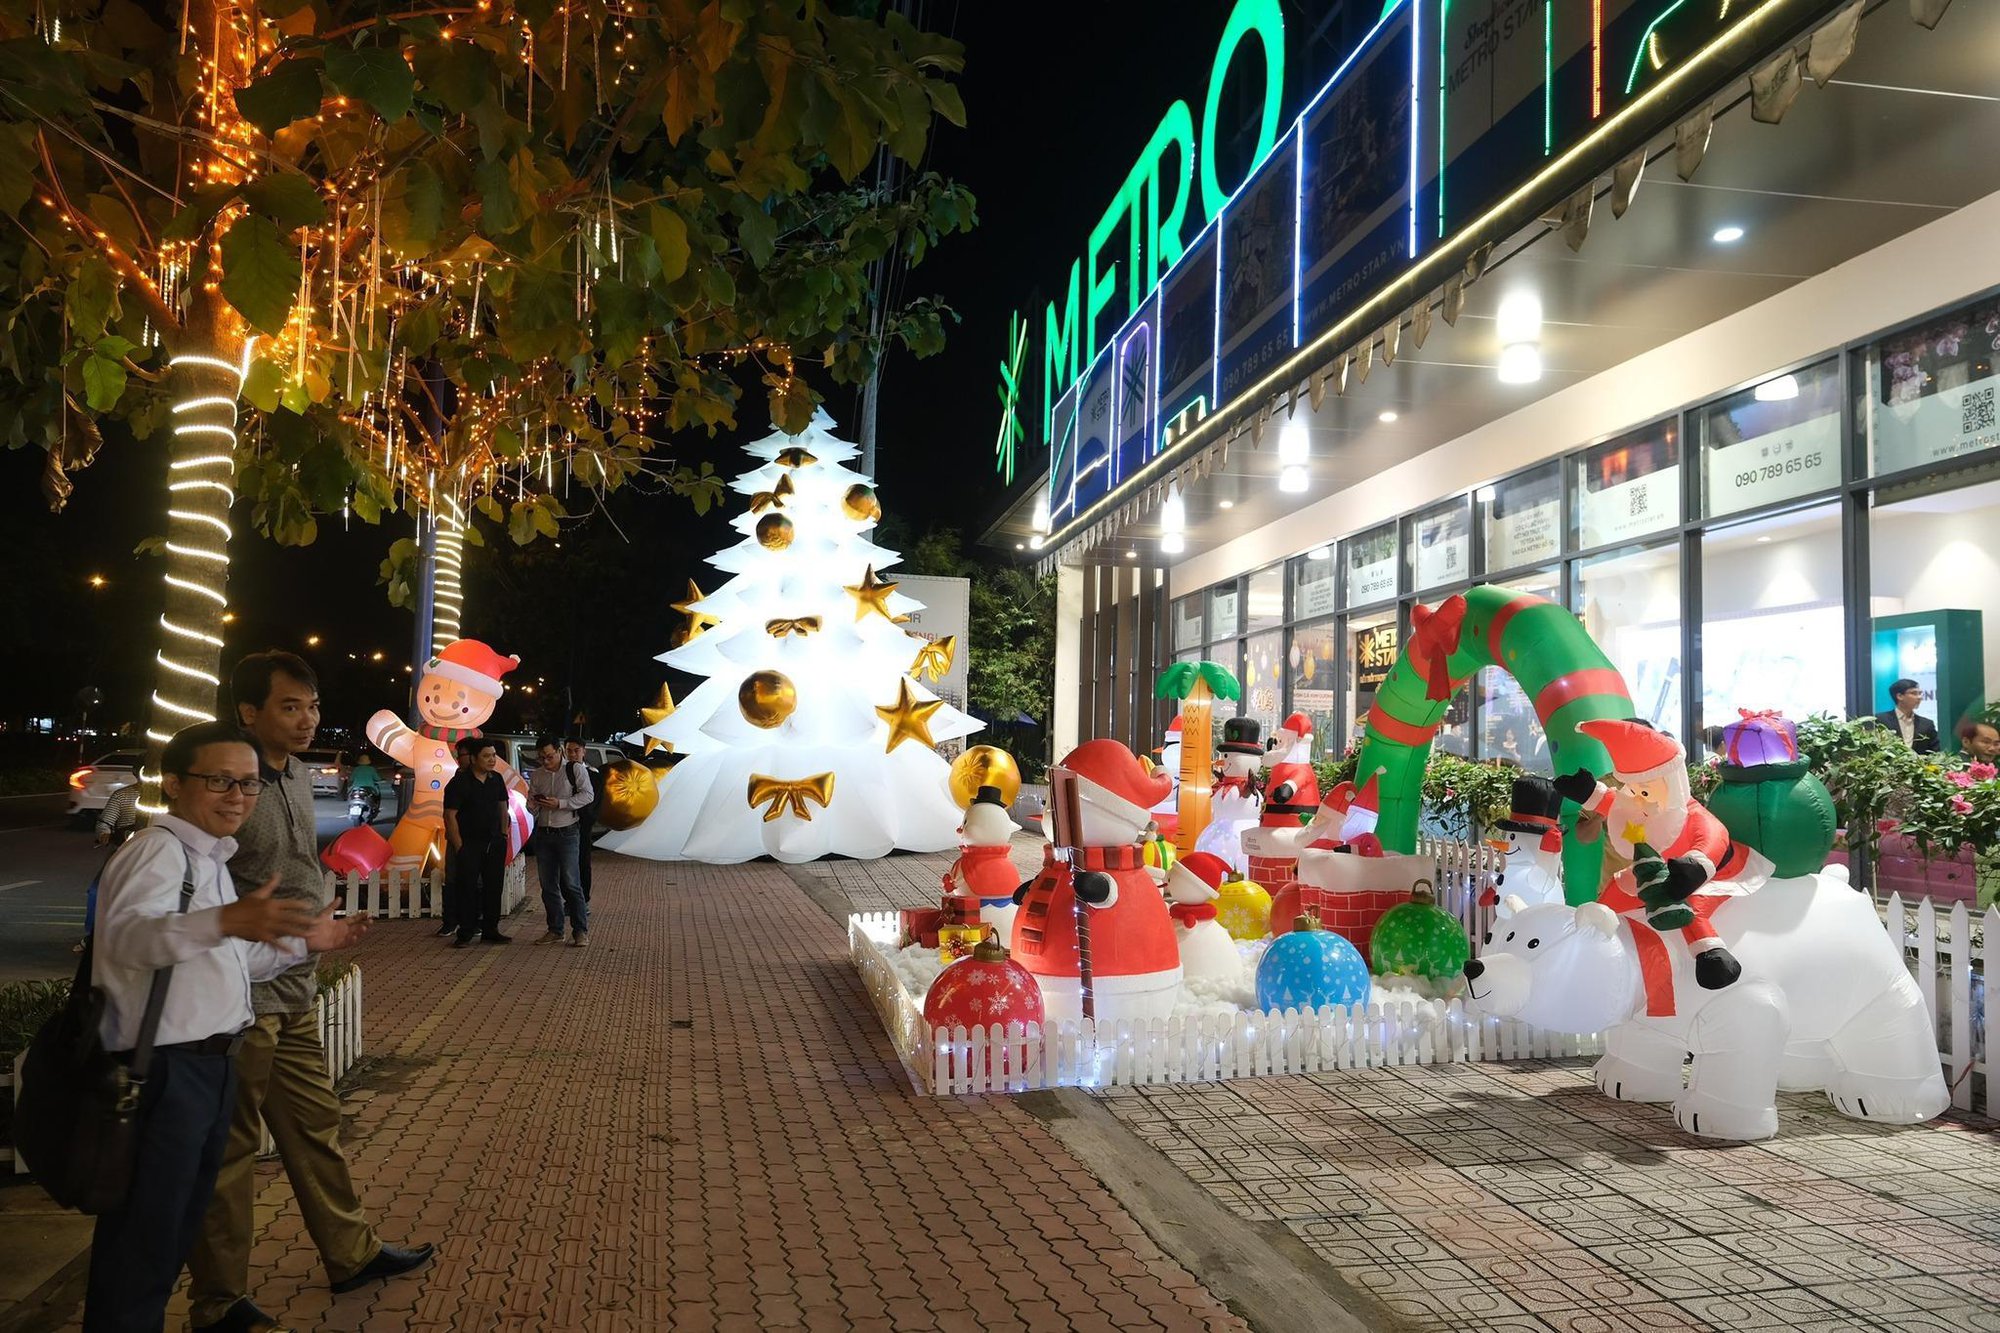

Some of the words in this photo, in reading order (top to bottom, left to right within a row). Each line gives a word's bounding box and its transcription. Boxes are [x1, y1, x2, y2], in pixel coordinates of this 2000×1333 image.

[1448, 29, 1500, 96] METRO
[1044, 0, 1285, 446] METRO
[1242, 353, 1258, 375] 789
[1261, 338, 1273, 361] 65
[1735, 470, 1757, 487] 090
[1760, 463, 1783, 481] 789
[1785, 457, 1802, 474] 65
[1804, 451, 1822, 469] 65
[1375, 628, 1397, 649] MET
[1375, 646, 1397, 667] STA
